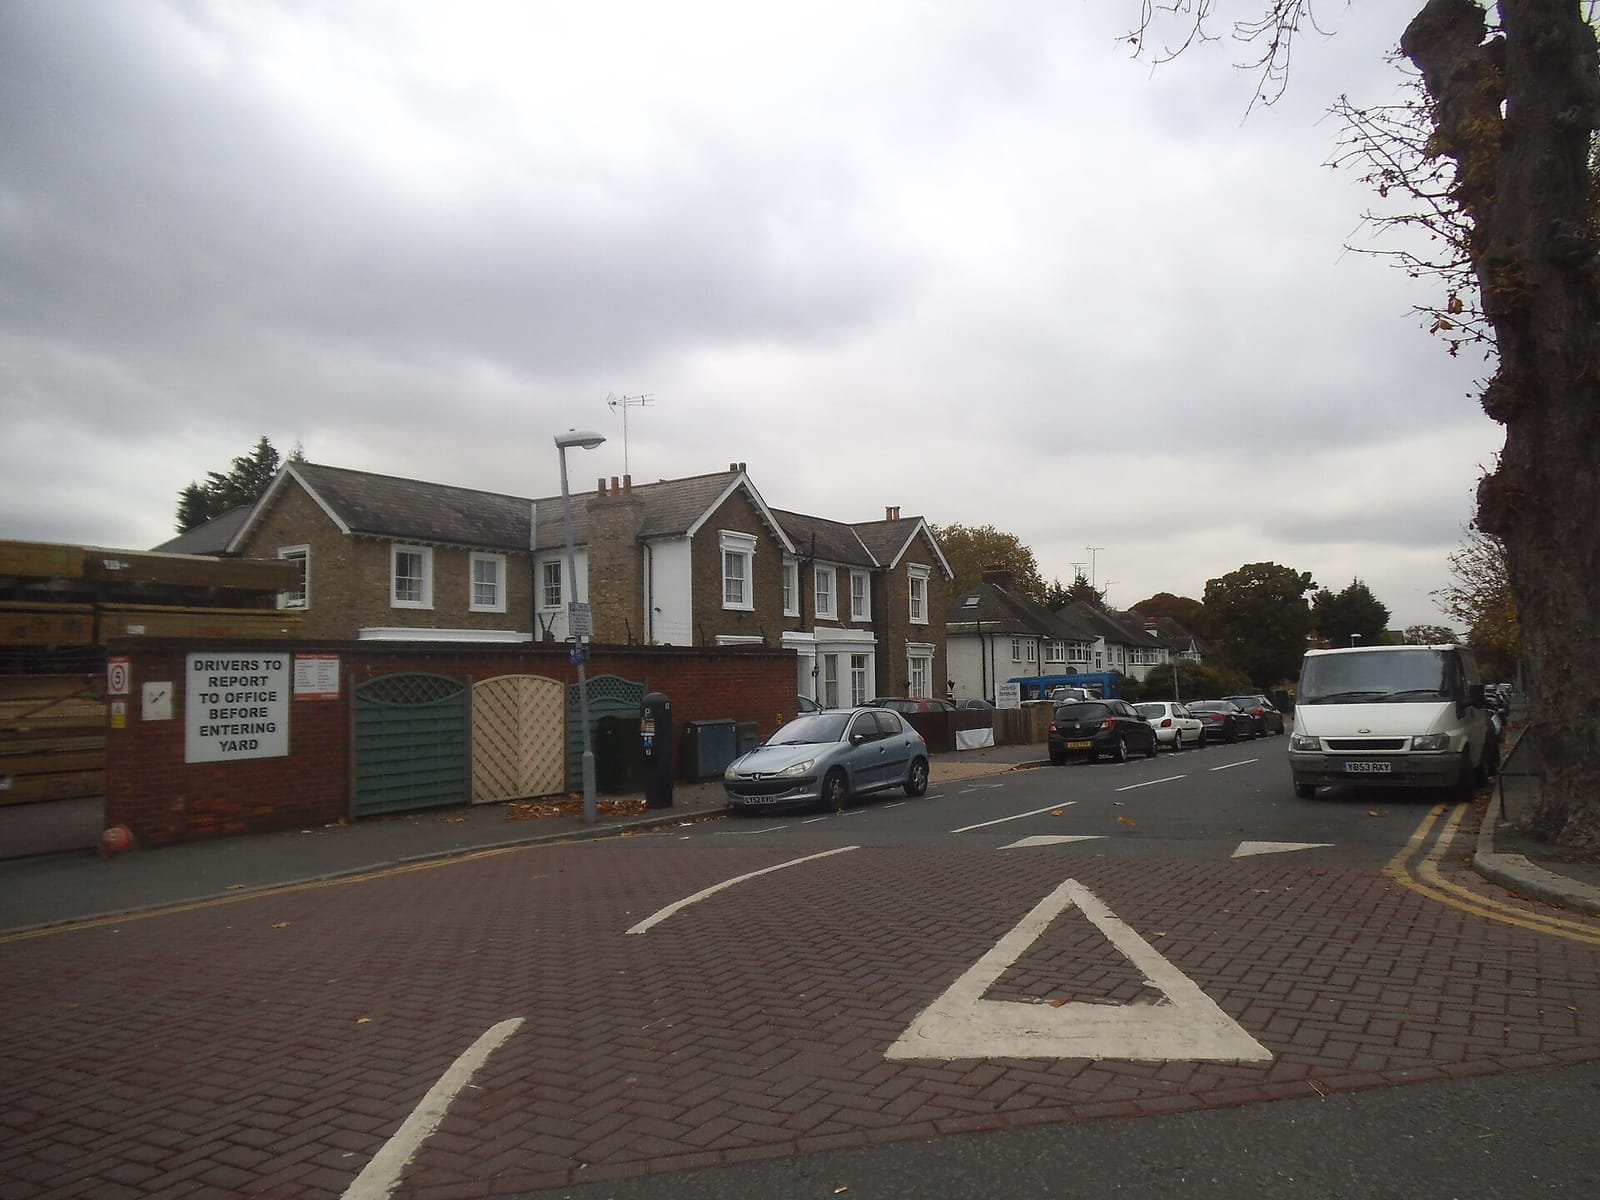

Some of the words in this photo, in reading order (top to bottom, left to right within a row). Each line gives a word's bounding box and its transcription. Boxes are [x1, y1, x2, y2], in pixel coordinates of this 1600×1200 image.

[193, 660, 259, 671] DRIVERS
[265, 660, 282, 671] TO
[115, 671, 121, 684] 5
[208, 676, 269, 687] REPORT
[199, 693, 219, 704] TO
[224, 691, 277, 703] OFFICE
[209, 707, 268, 719] BEFORE
[200, 722, 276, 736] ENTERING
[219, 739, 258, 751] YARD
